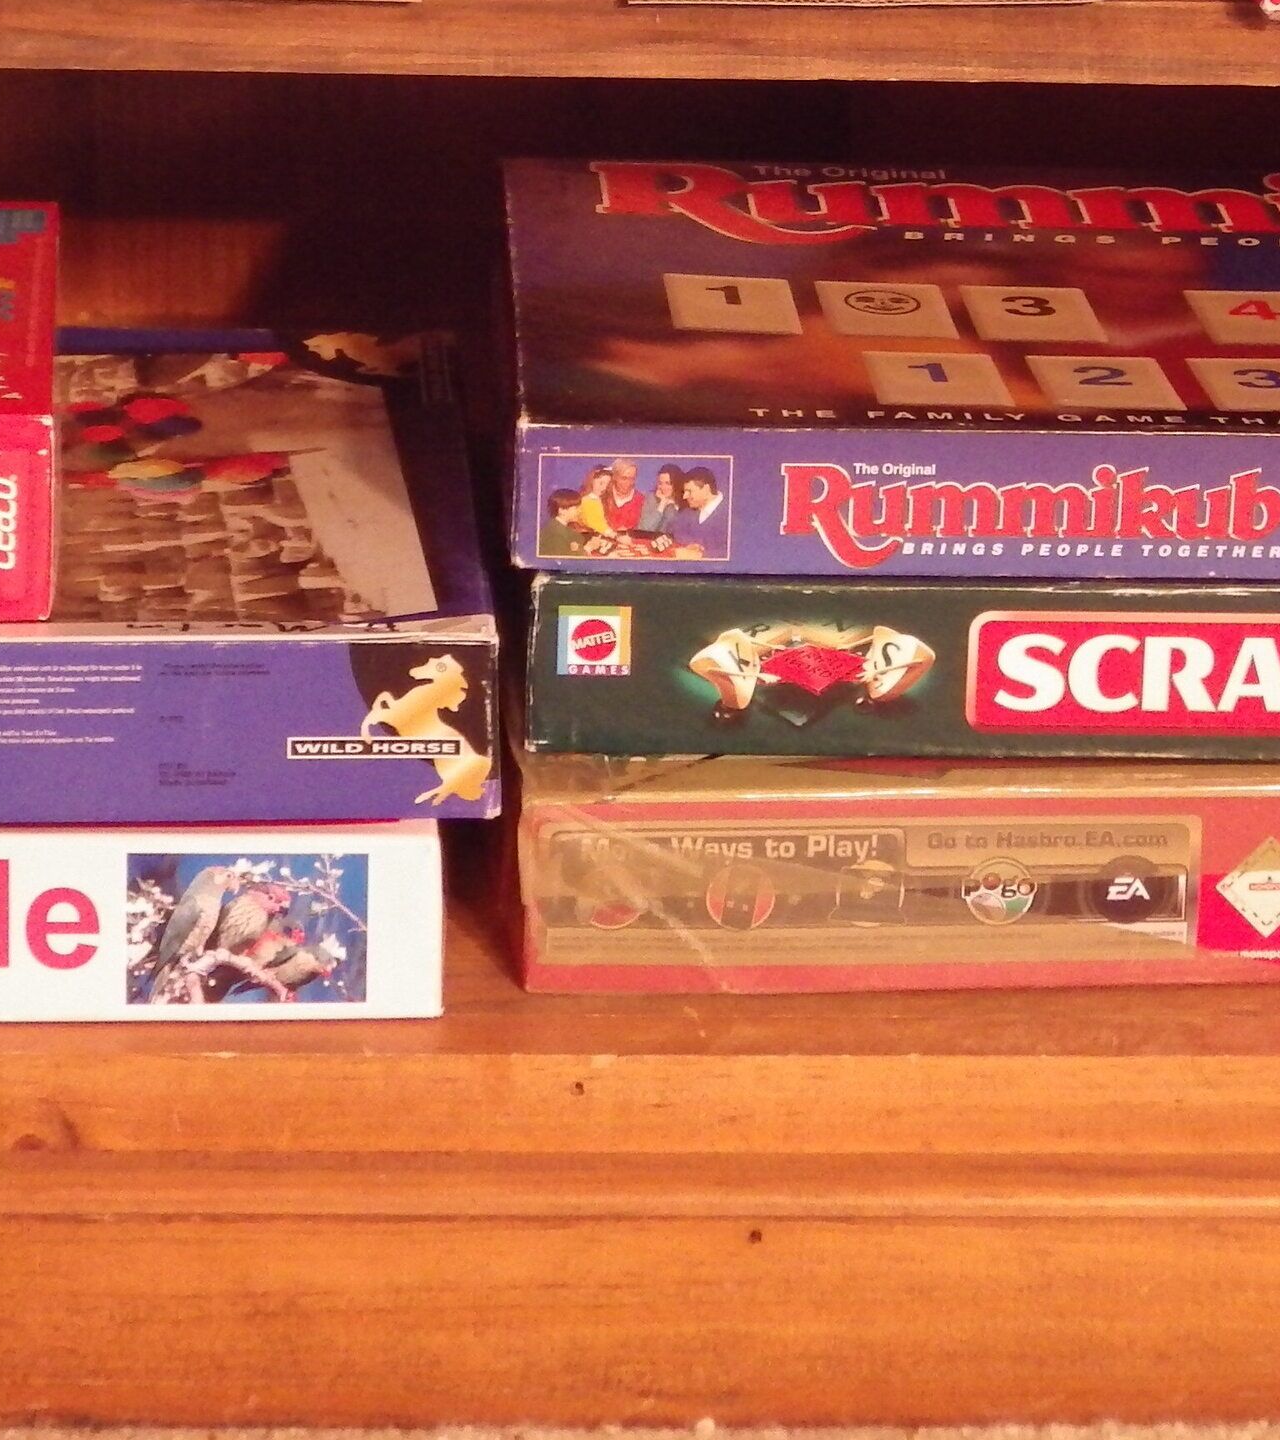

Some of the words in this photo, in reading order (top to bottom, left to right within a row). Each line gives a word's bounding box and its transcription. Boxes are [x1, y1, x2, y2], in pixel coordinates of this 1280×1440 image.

[753, 164, 810, 178] The
[823, 166, 948, 182] Original
[903, 231, 1117, 245] BRINGS
[706, 284, 742, 304] 1
[1001, 295, 1055, 316] 3
[1228, 300, 1280, 321] 4
[906, 362, 950, 383] 1
[1072, 366, 1133, 387] 2
[749, 407, 837, 419] THE
[865, 409, 1025, 422] FAMILY
[1057, 412, 1185, 424] GAME
[852, 462, 879, 476] The
[882, 462, 936, 478] Original
[902, 541, 1006, 556] BRINGS
[1021, 543, 1124, 557] PEOPLE
[571, 631, 617, 650] MATTEL
[568, 664, 630, 676] GAMES
[294, 743, 364, 754] WILD
[372, 742, 456, 754] HORSE
[765, 839, 796, 858] to
[805, 834, 879, 861] Play!
[927, 830, 956, 850] Go
[963, 832, 988, 849] to
[1106, 877, 1152, 902] EA
